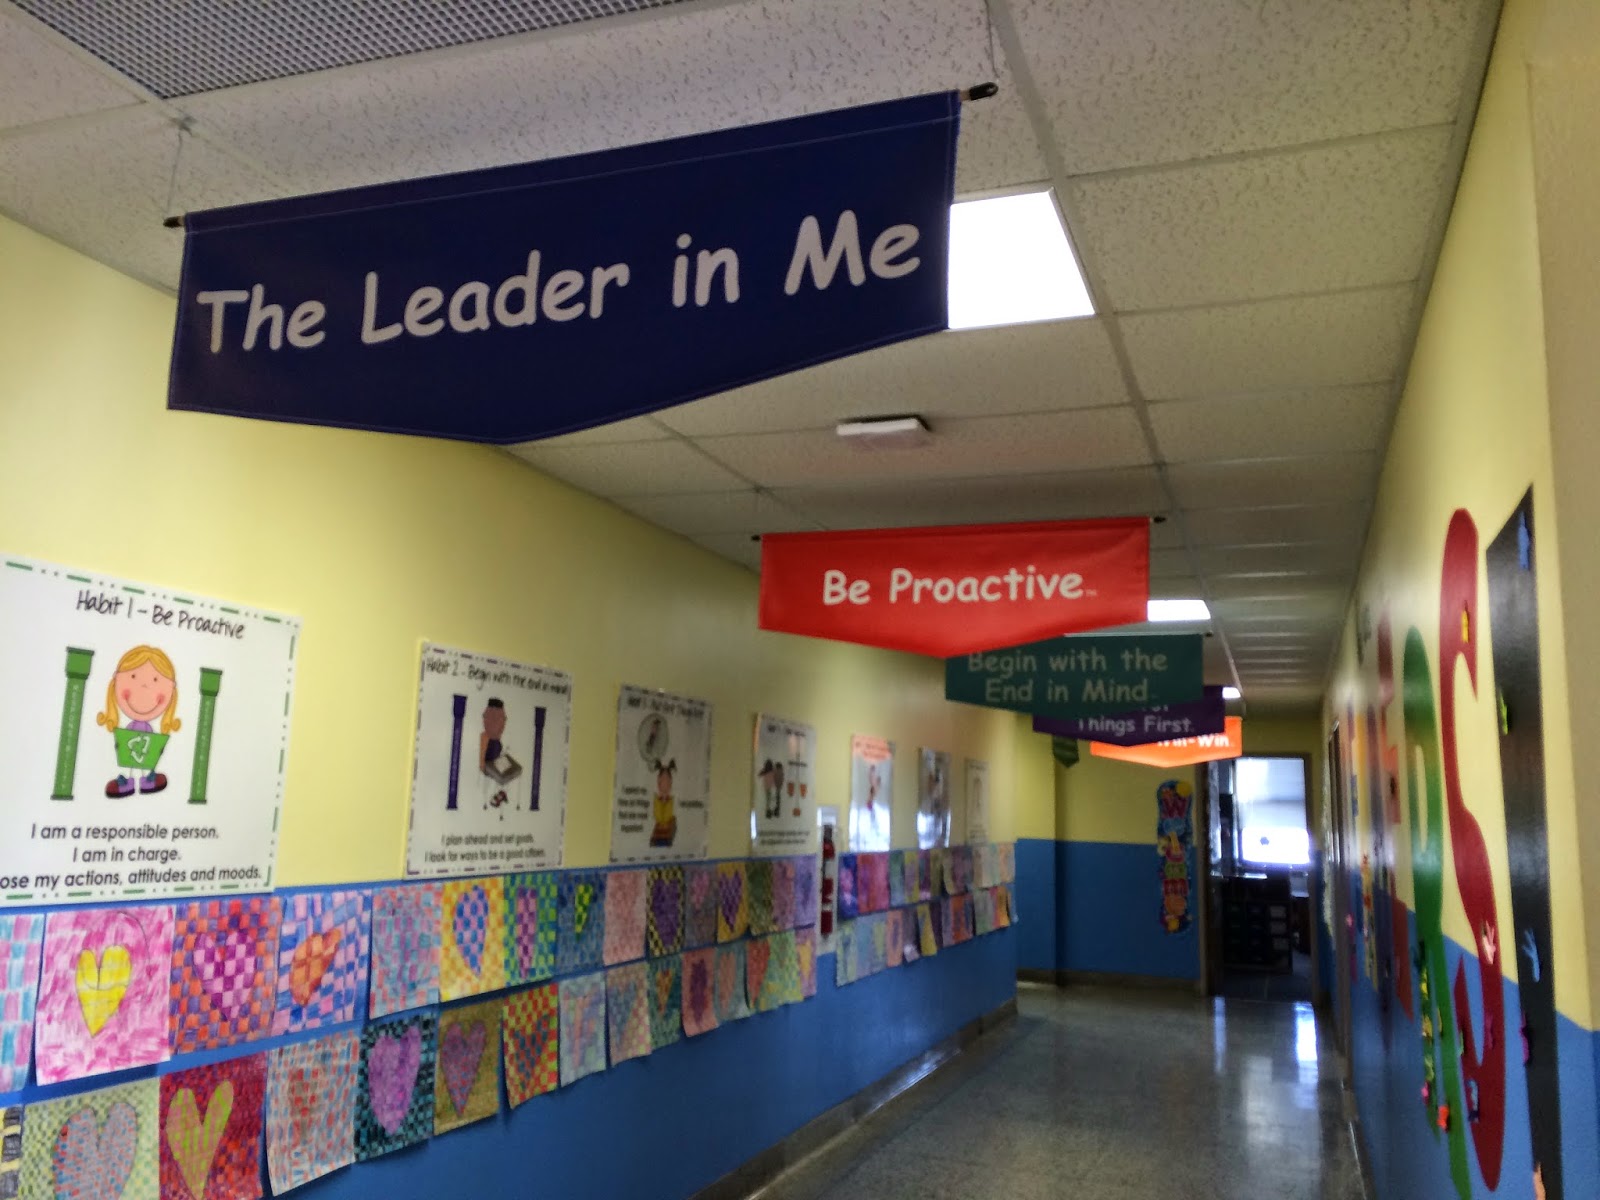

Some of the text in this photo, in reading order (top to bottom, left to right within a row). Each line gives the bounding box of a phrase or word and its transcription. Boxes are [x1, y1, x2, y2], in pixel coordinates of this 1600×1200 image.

[196, 209, 920, 355] The Leader in Me
[823, 569, 870, 605] Be
[889, 565, 1083, 604] Proactive
[76, 590, 122, 616] Habit
[152, 605, 173, 625] Be
[178, 609, 245, 640] Proactive
[426, 656, 450, 674] Habit
[968, 647, 1168, 679] Begin with the
[985, 678, 1033, 702] End
[1047, 679, 1069, 702] in
[1078, 716, 1135, 737] Things
[1158, 734, 1229, 747] in-Win
[31, 823, 219, 842] I am a responsible person.
[72, 846, 181, 865] I am in charge.
[34, 873, 58, 891] my
[64, 870, 123, 887] actions,
[128, 866, 186, 885] attitudes
[190, 866, 215, 882] and
[218, 865, 261, 881] moods.
